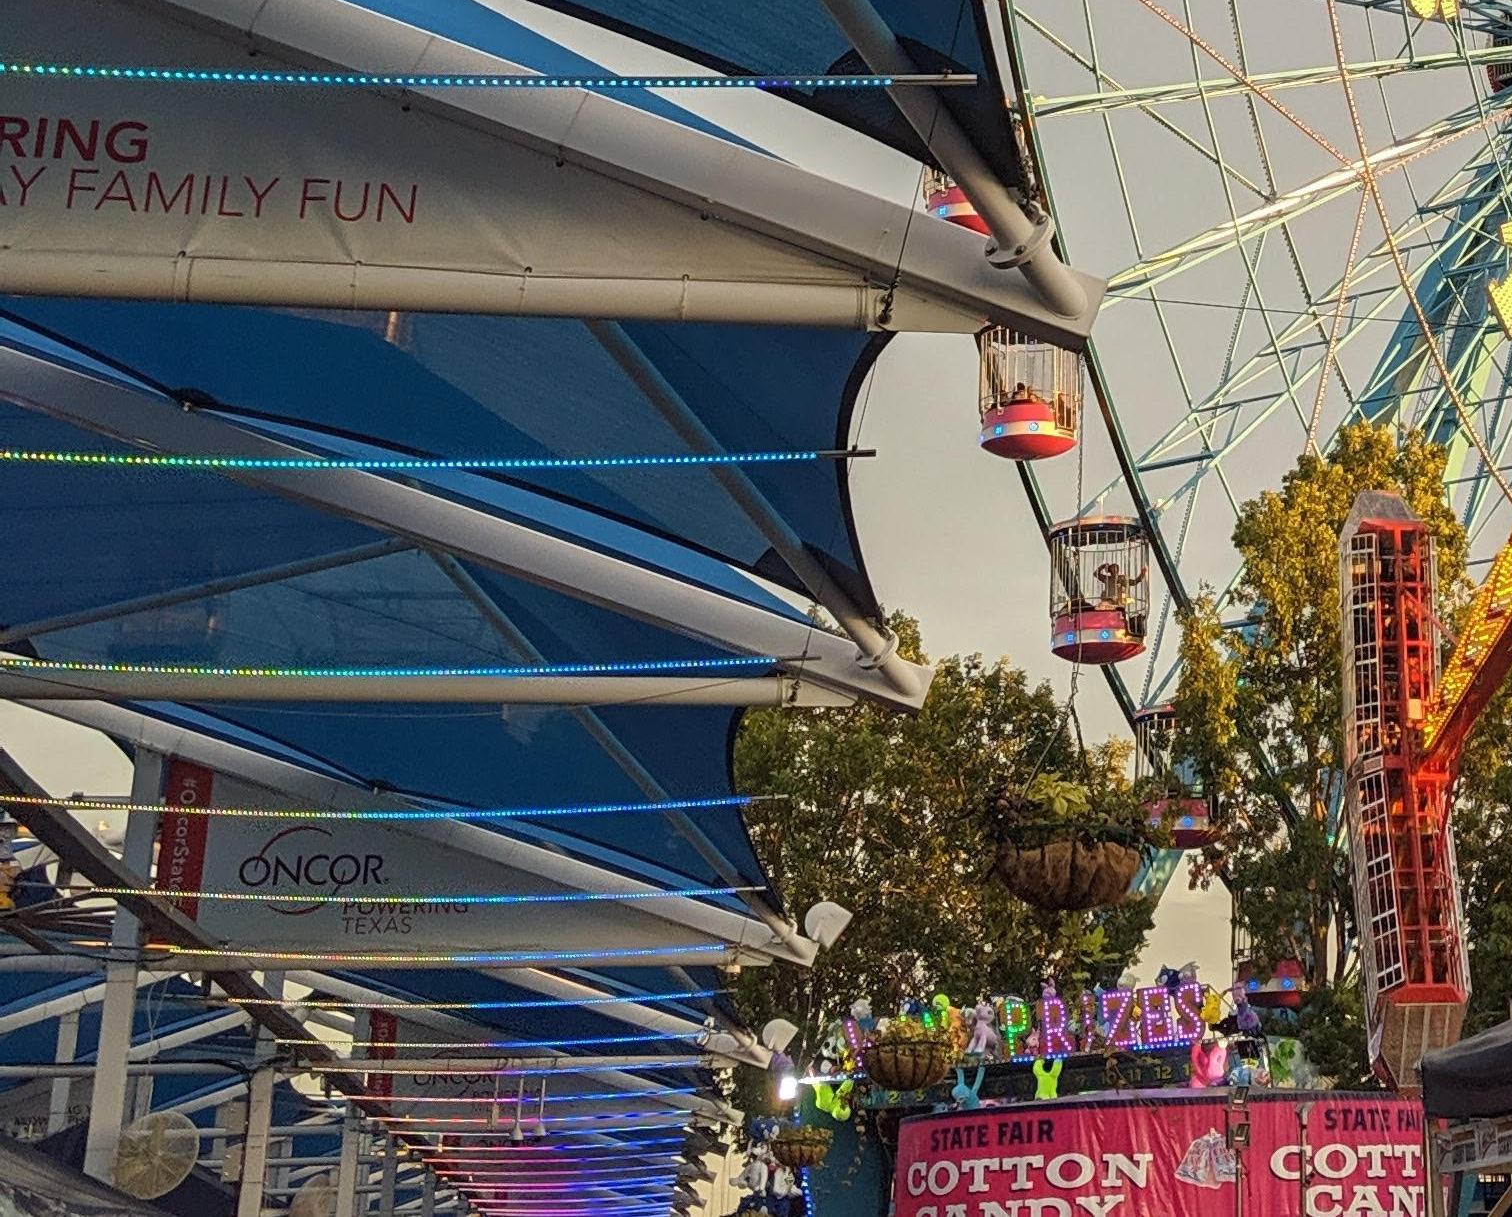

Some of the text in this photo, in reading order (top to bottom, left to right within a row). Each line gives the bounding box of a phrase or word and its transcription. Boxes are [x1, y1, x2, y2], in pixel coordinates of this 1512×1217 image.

[0, 164, 418, 224] Y FAMILY FUN
[239, 854, 385, 887] ONCOR
[341, 916, 413, 935] TEXAS
[1004, 983, 1202, 1059] PRIZES
[1154, 1065, 1173, 1080] 12
[931, 1119, 1055, 1153] STATE FAIR
[1324, 1108, 1390, 1131] STATE
[907, 1152, 1154, 1196] COTTON
